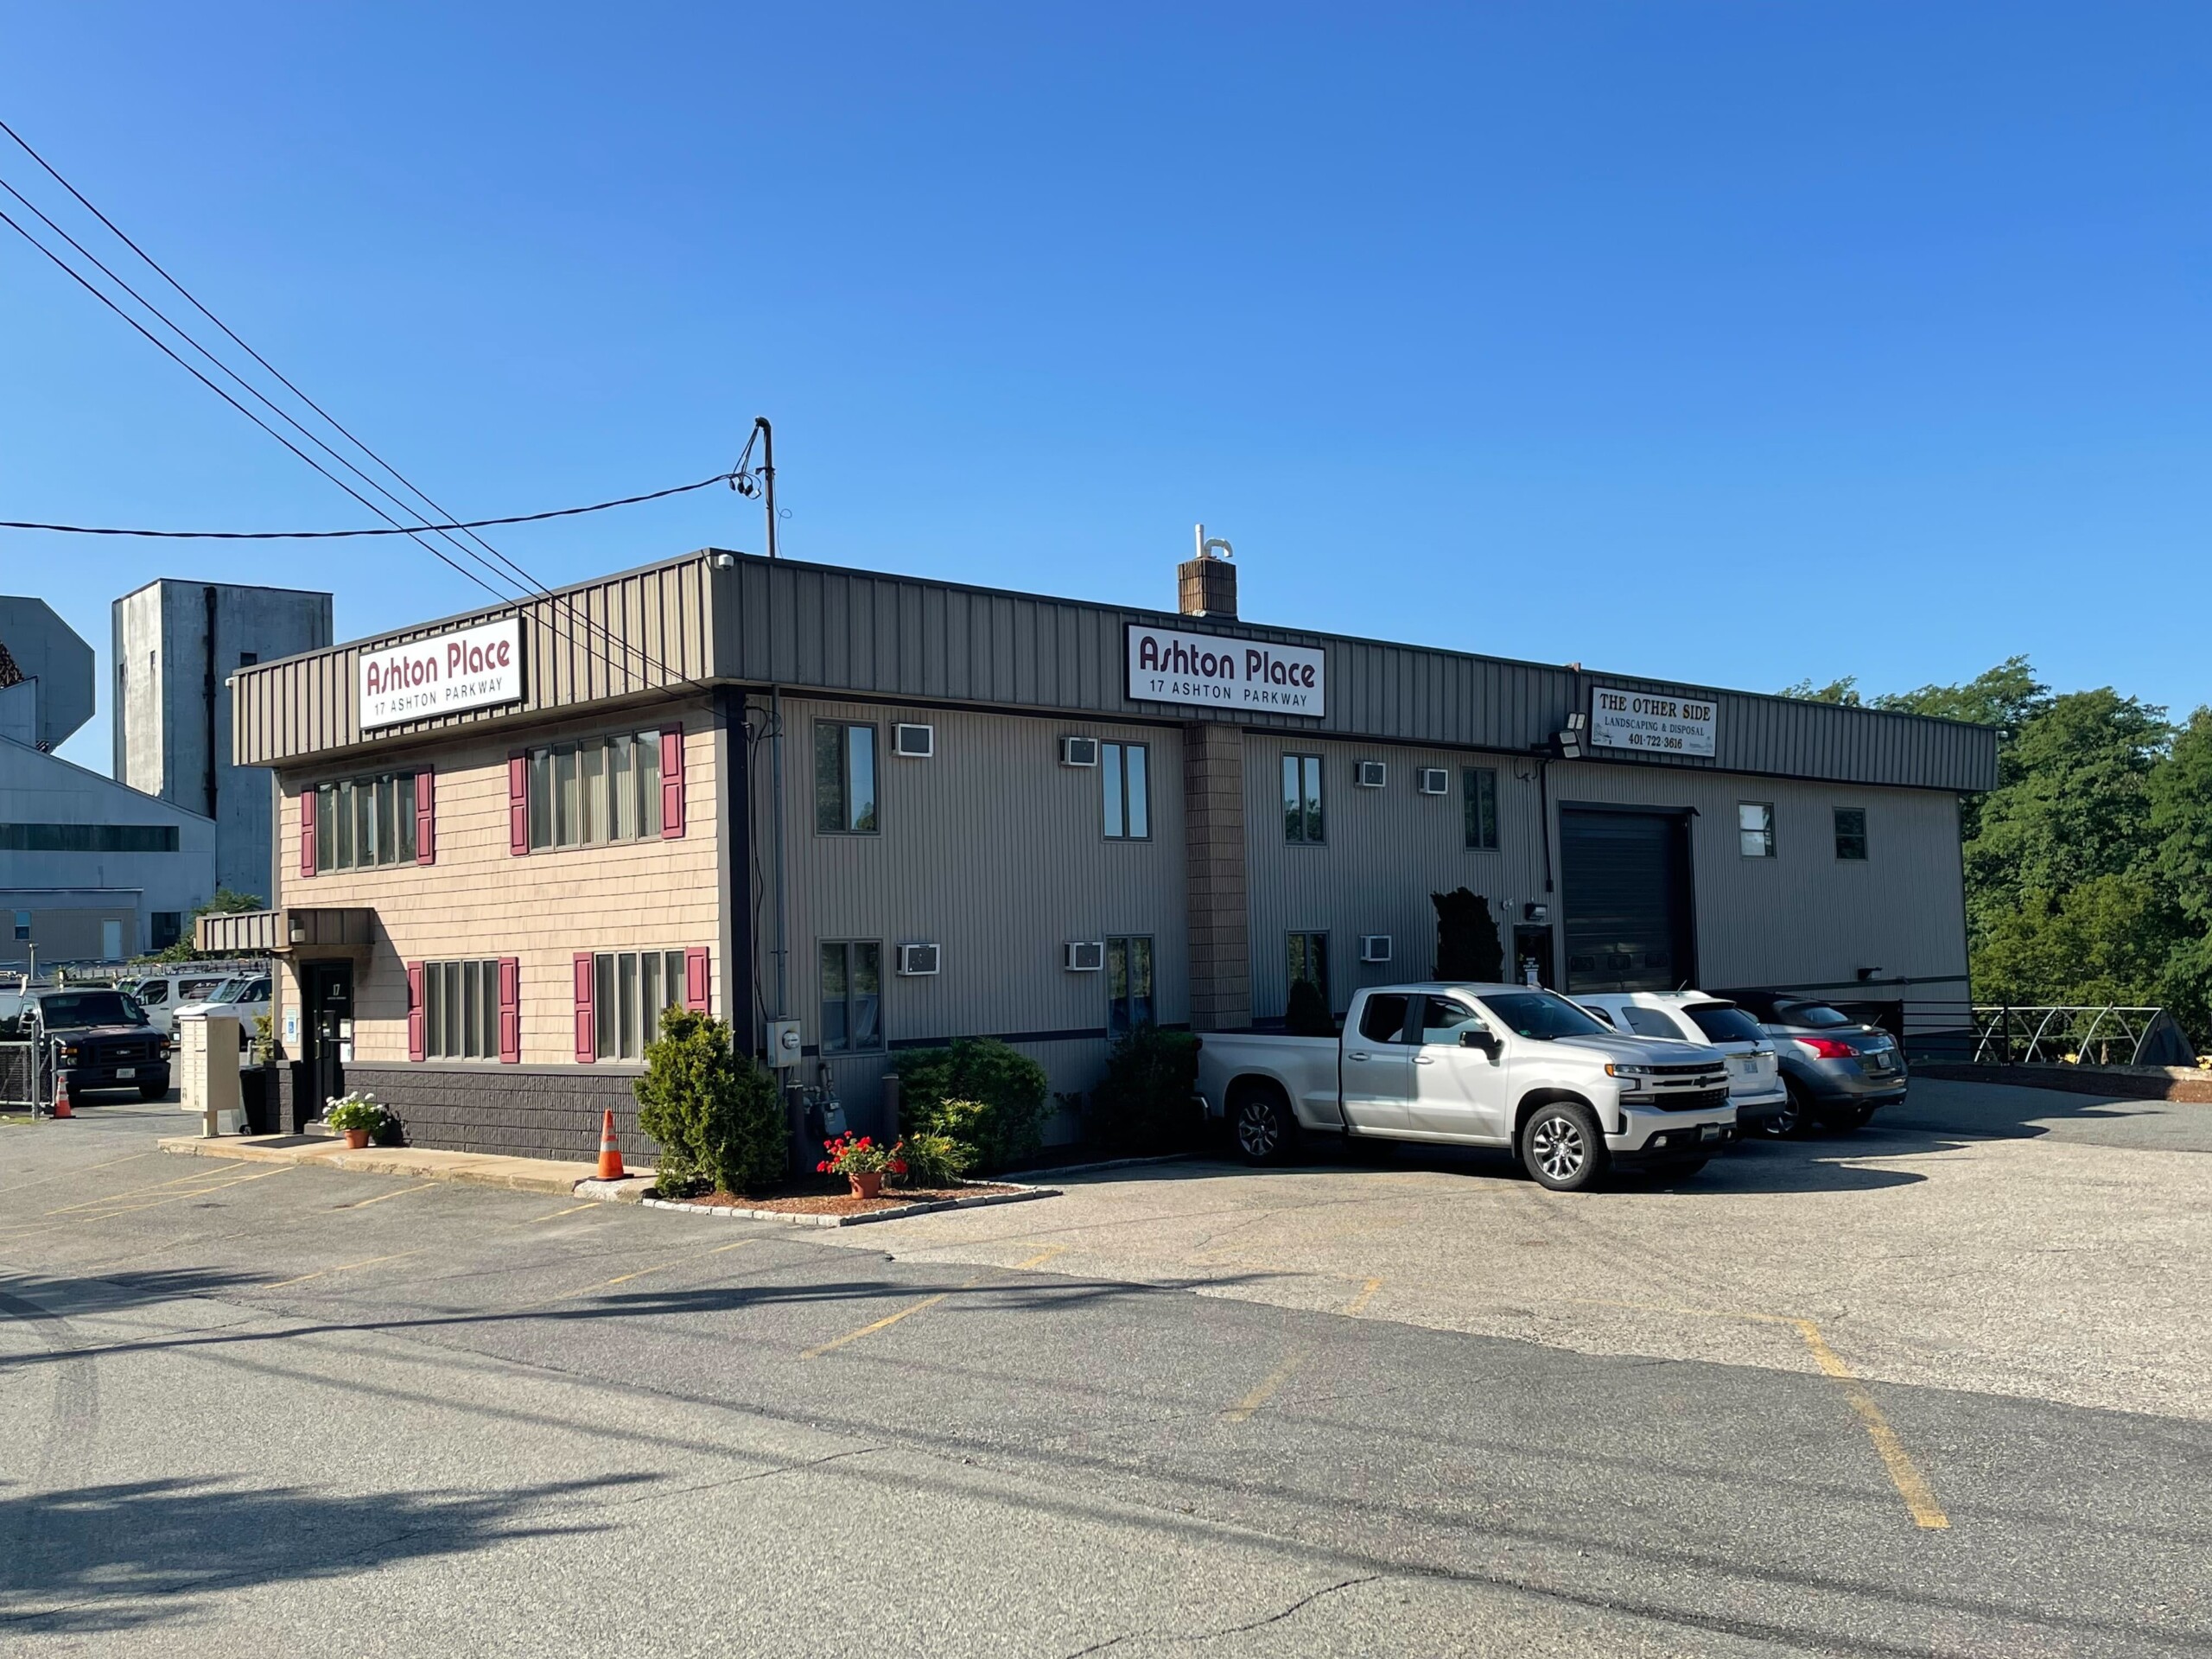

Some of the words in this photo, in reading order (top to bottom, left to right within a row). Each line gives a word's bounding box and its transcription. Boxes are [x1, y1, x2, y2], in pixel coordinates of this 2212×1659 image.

[367, 656, 437, 696] Ashton
[448, 639, 510, 678] Place
[1141, 636, 1234, 679] Ashton
[1246, 649, 1315, 688] Place
[375, 702, 385, 715] 17
[391, 692, 436, 713] ASHTON
[446, 677, 503, 701] PARKWAY
[1150, 679, 1164, 692] 17
[1173, 682, 1231, 699] ASHTON
[1244, 689, 1307, 707] PARKWAY
[1599, 693, 1627, 711] THE
[1632, 697, 1677, 717] OTHER
[1682, 704, 1711, 721] SIDE
[1605, 716, 1658, 732] LANDSCAPING
[1661, 723, 1667, 732] &
[1669, 724, 1705, 736] DISPOSAL
[334, 983, 340, 995] 17
